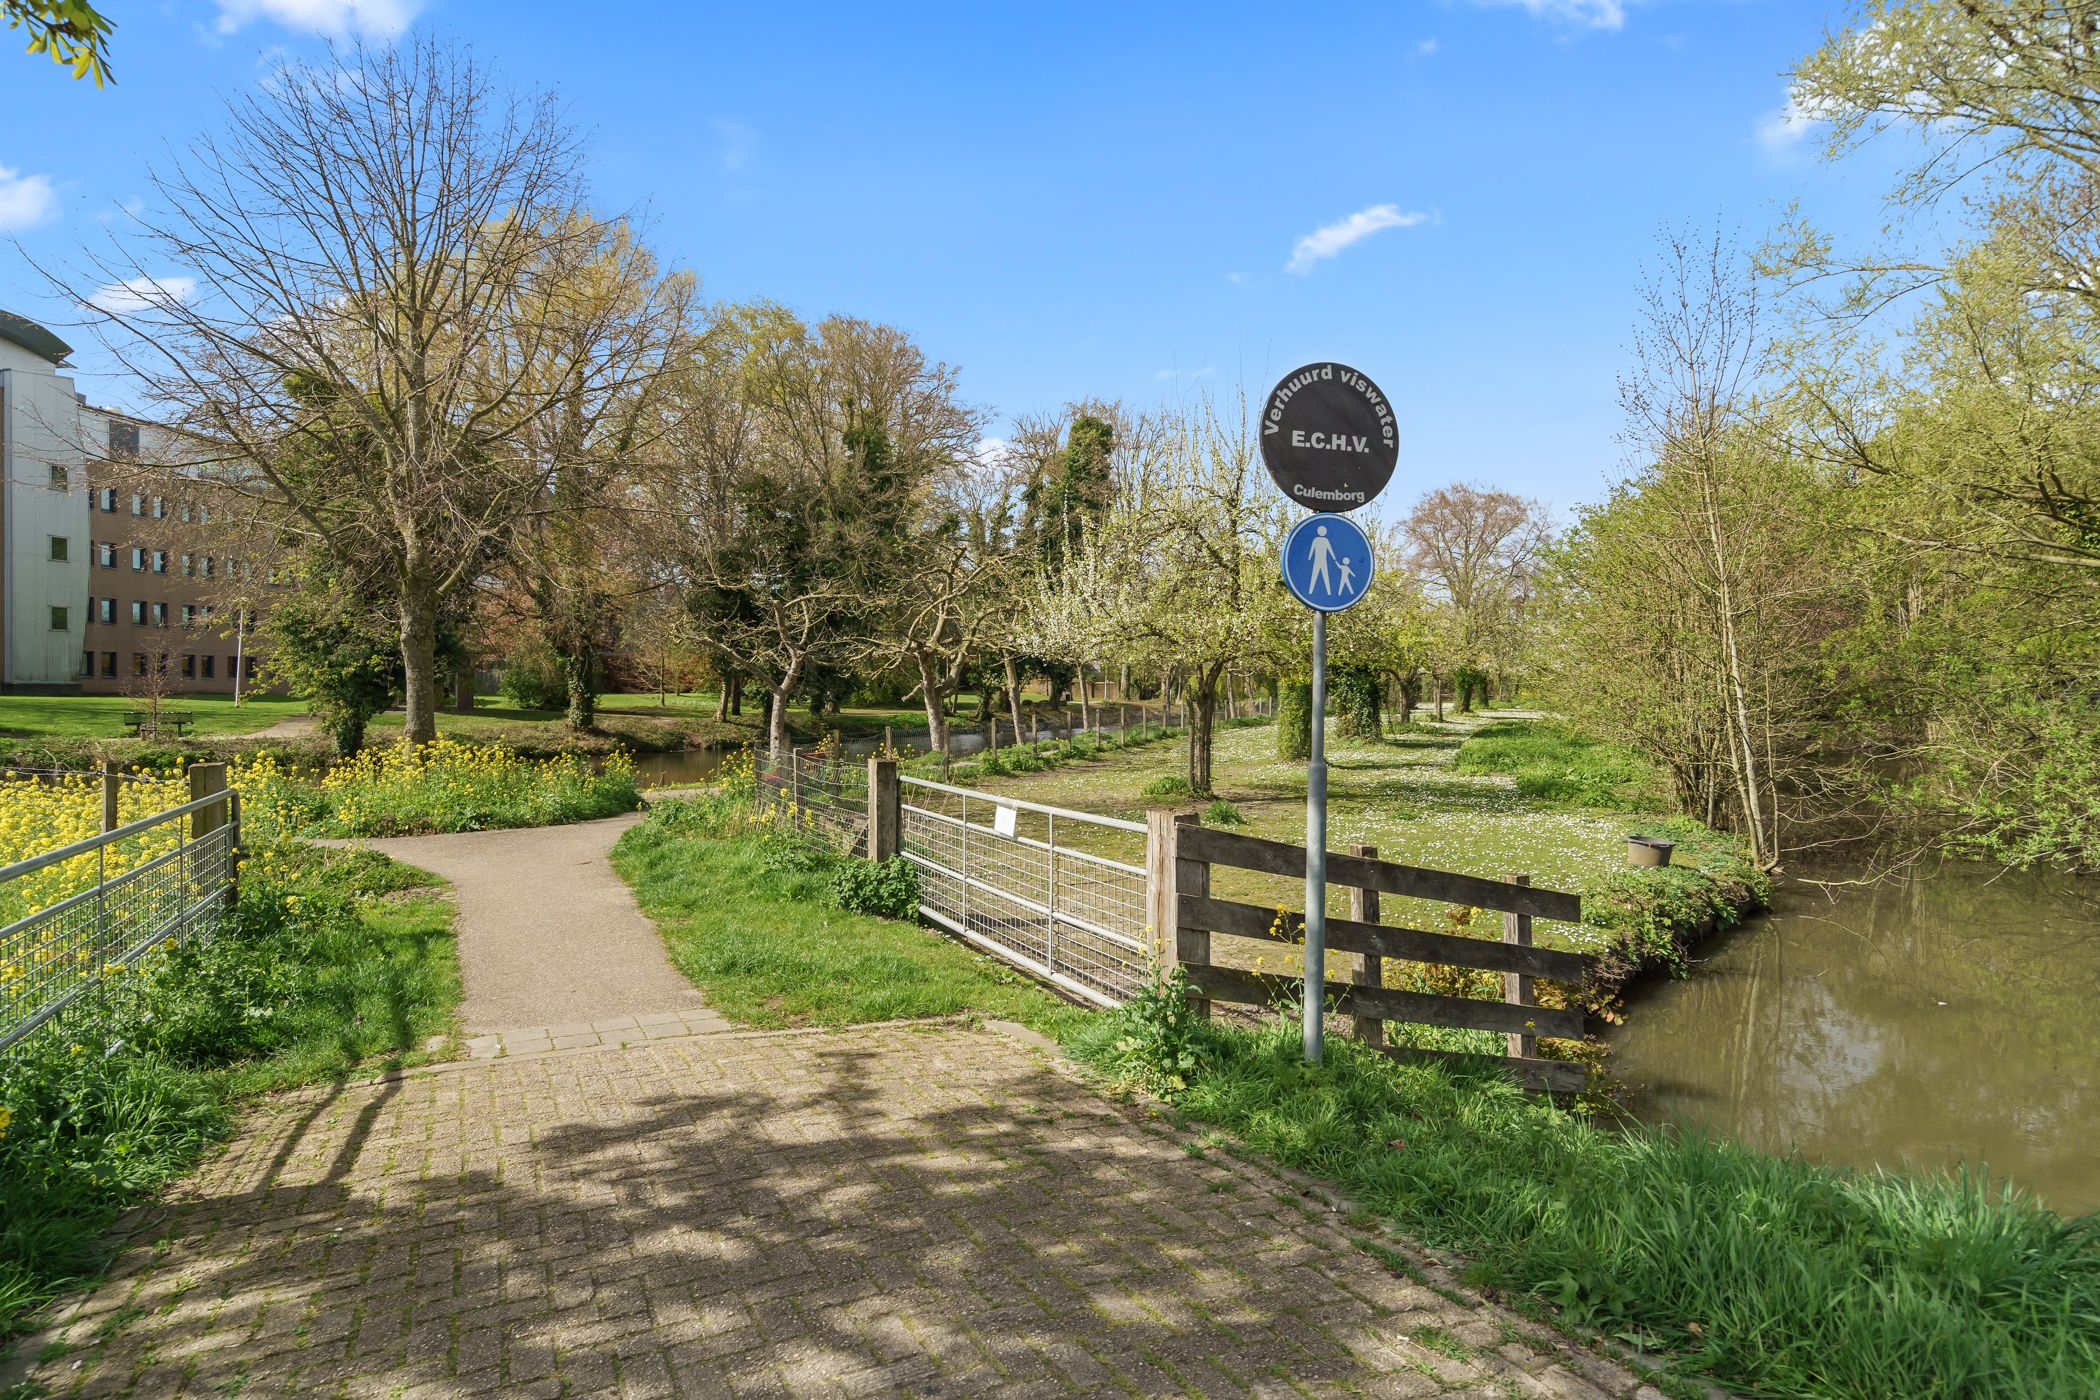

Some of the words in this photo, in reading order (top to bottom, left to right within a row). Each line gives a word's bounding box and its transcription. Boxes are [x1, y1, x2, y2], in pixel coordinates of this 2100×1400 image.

[1264, 365, 1332, 436] Verhuurd
[1340, 370, 1394, 449] viswater
[1291, 430, 1370, 453] E.C.H.V.
[1293, 484, 1365, 503] Culemborg
